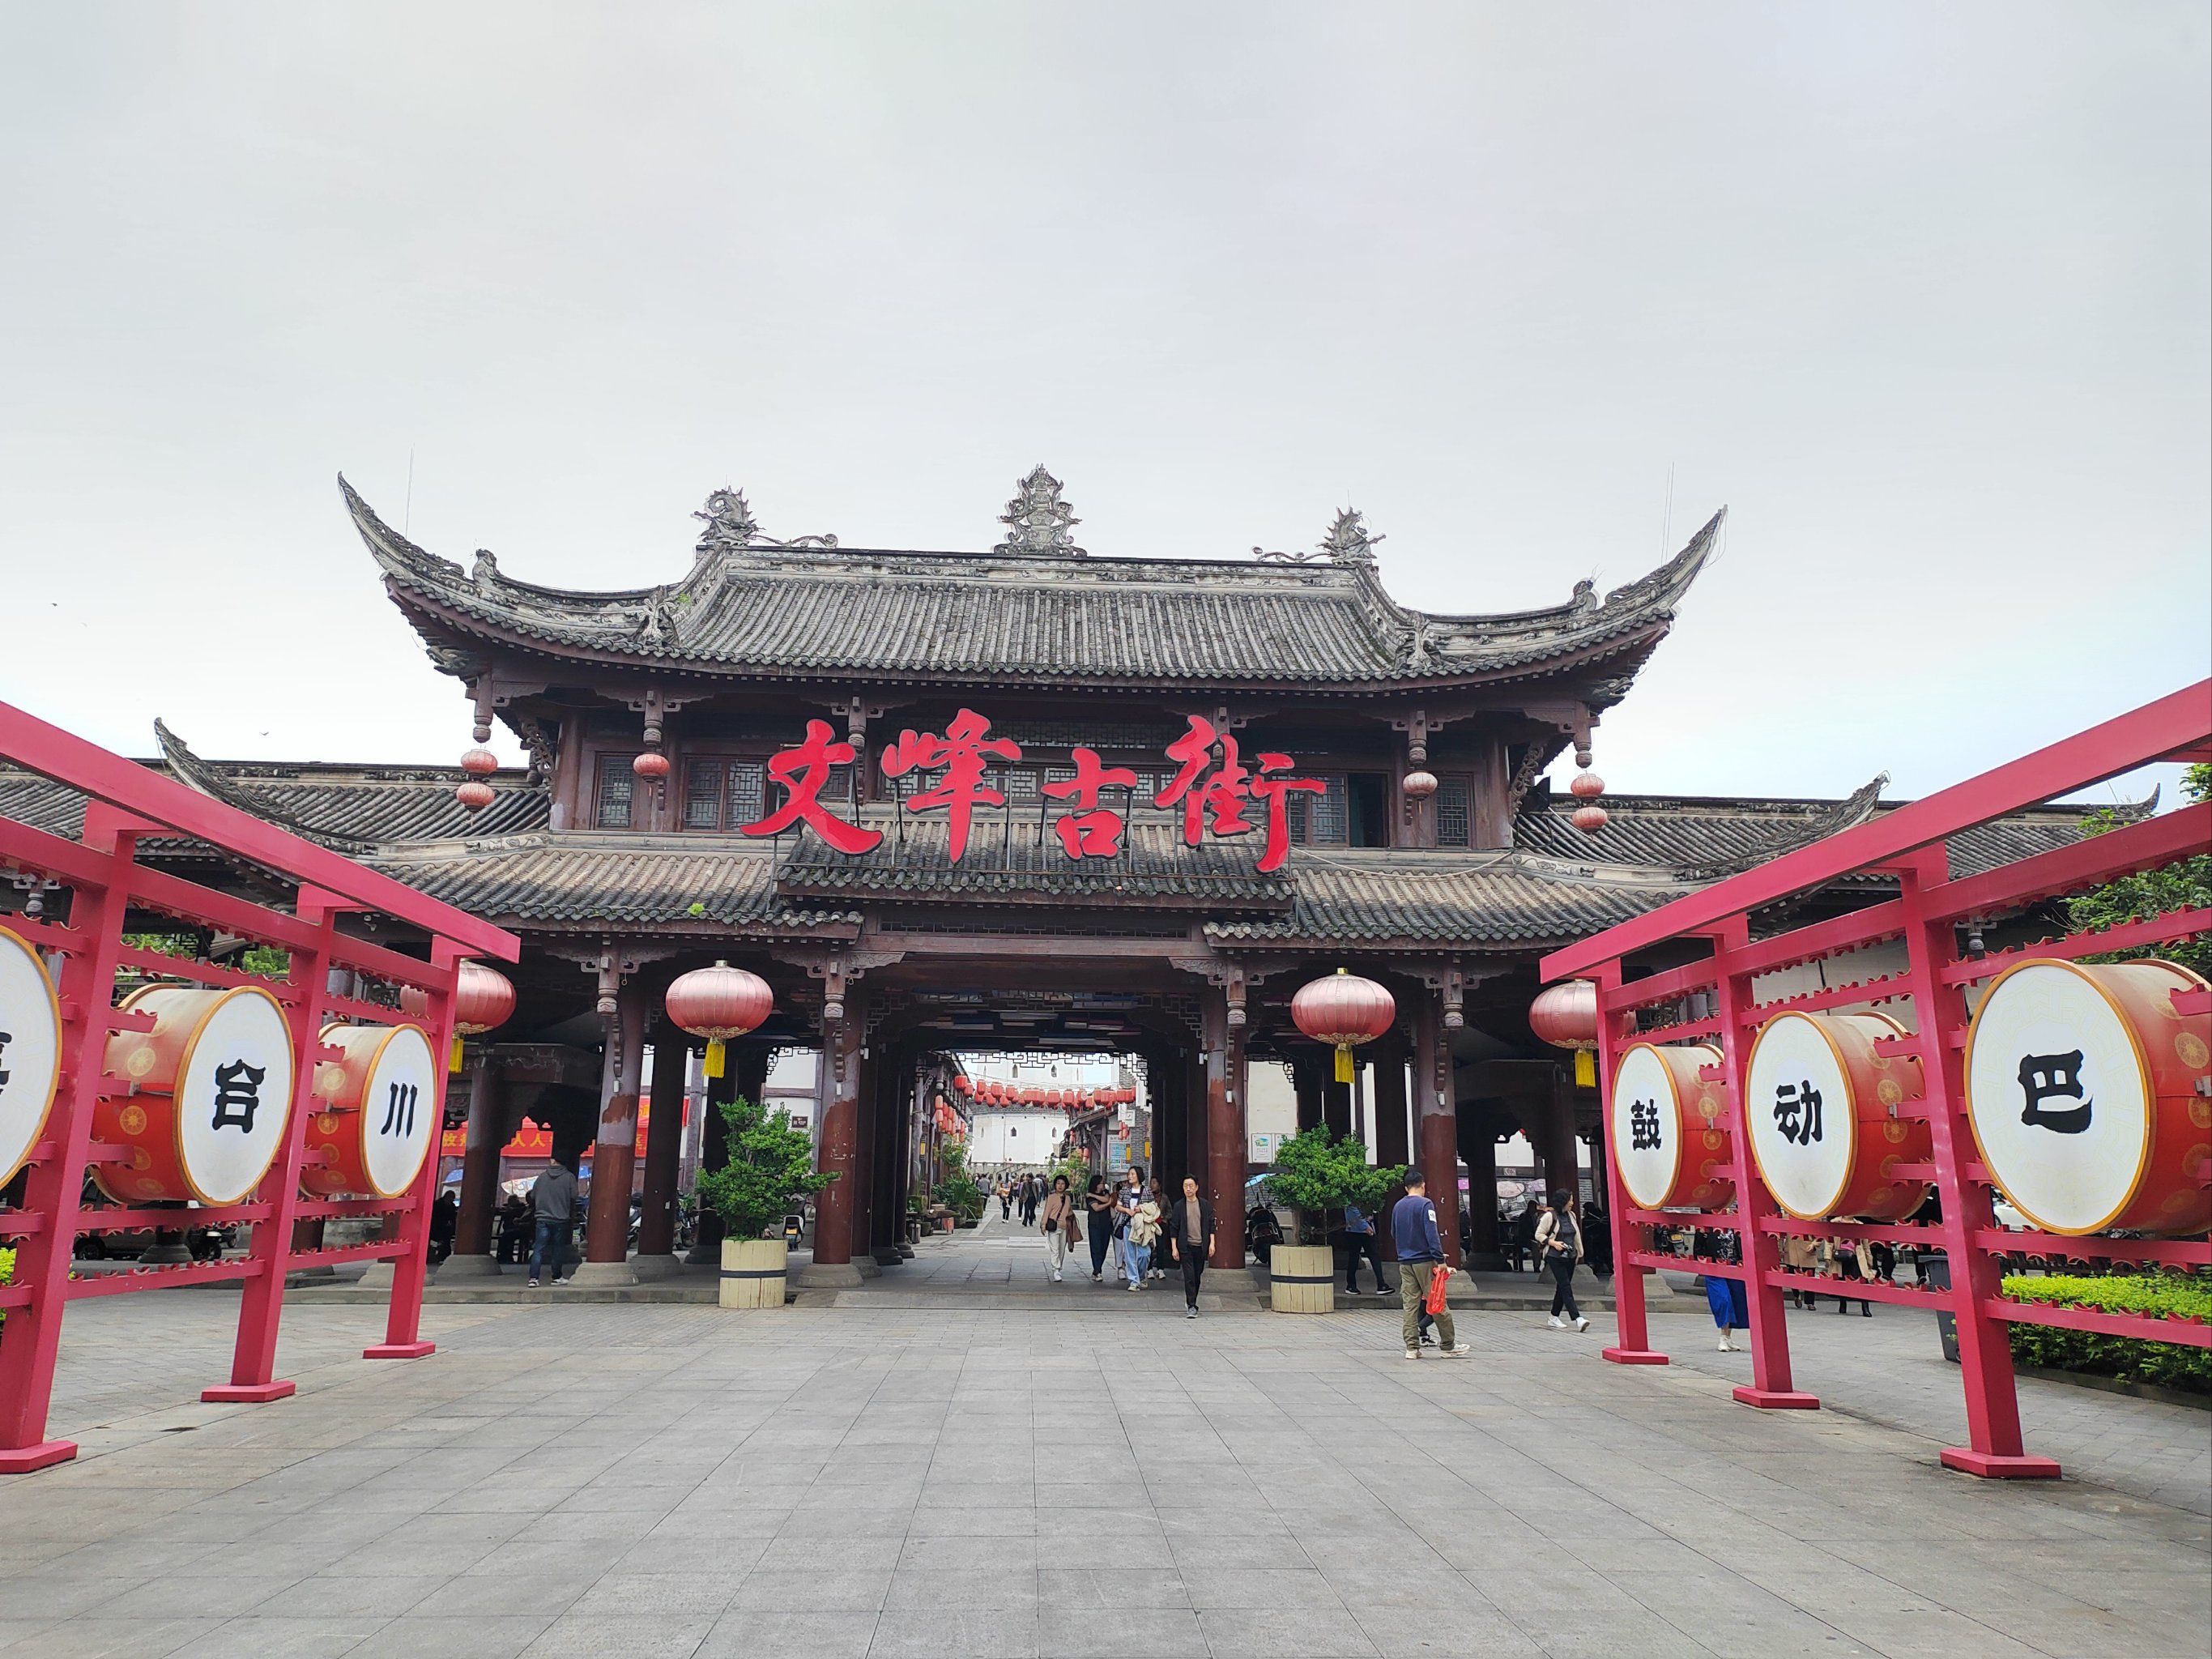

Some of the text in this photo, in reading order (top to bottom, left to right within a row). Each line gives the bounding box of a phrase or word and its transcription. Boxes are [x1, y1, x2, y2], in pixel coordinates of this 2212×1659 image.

[740, 708, 1327, 873] 文峰古街
[212, 1059, 266, 1134] 合
[381, 1082, 417, 1137] 川
[1630, 1098, 1662, 1151] 鼓
[1774, 1080, 1823, 1146] 动
[2017, 1049, 2093, 1134] 巴
